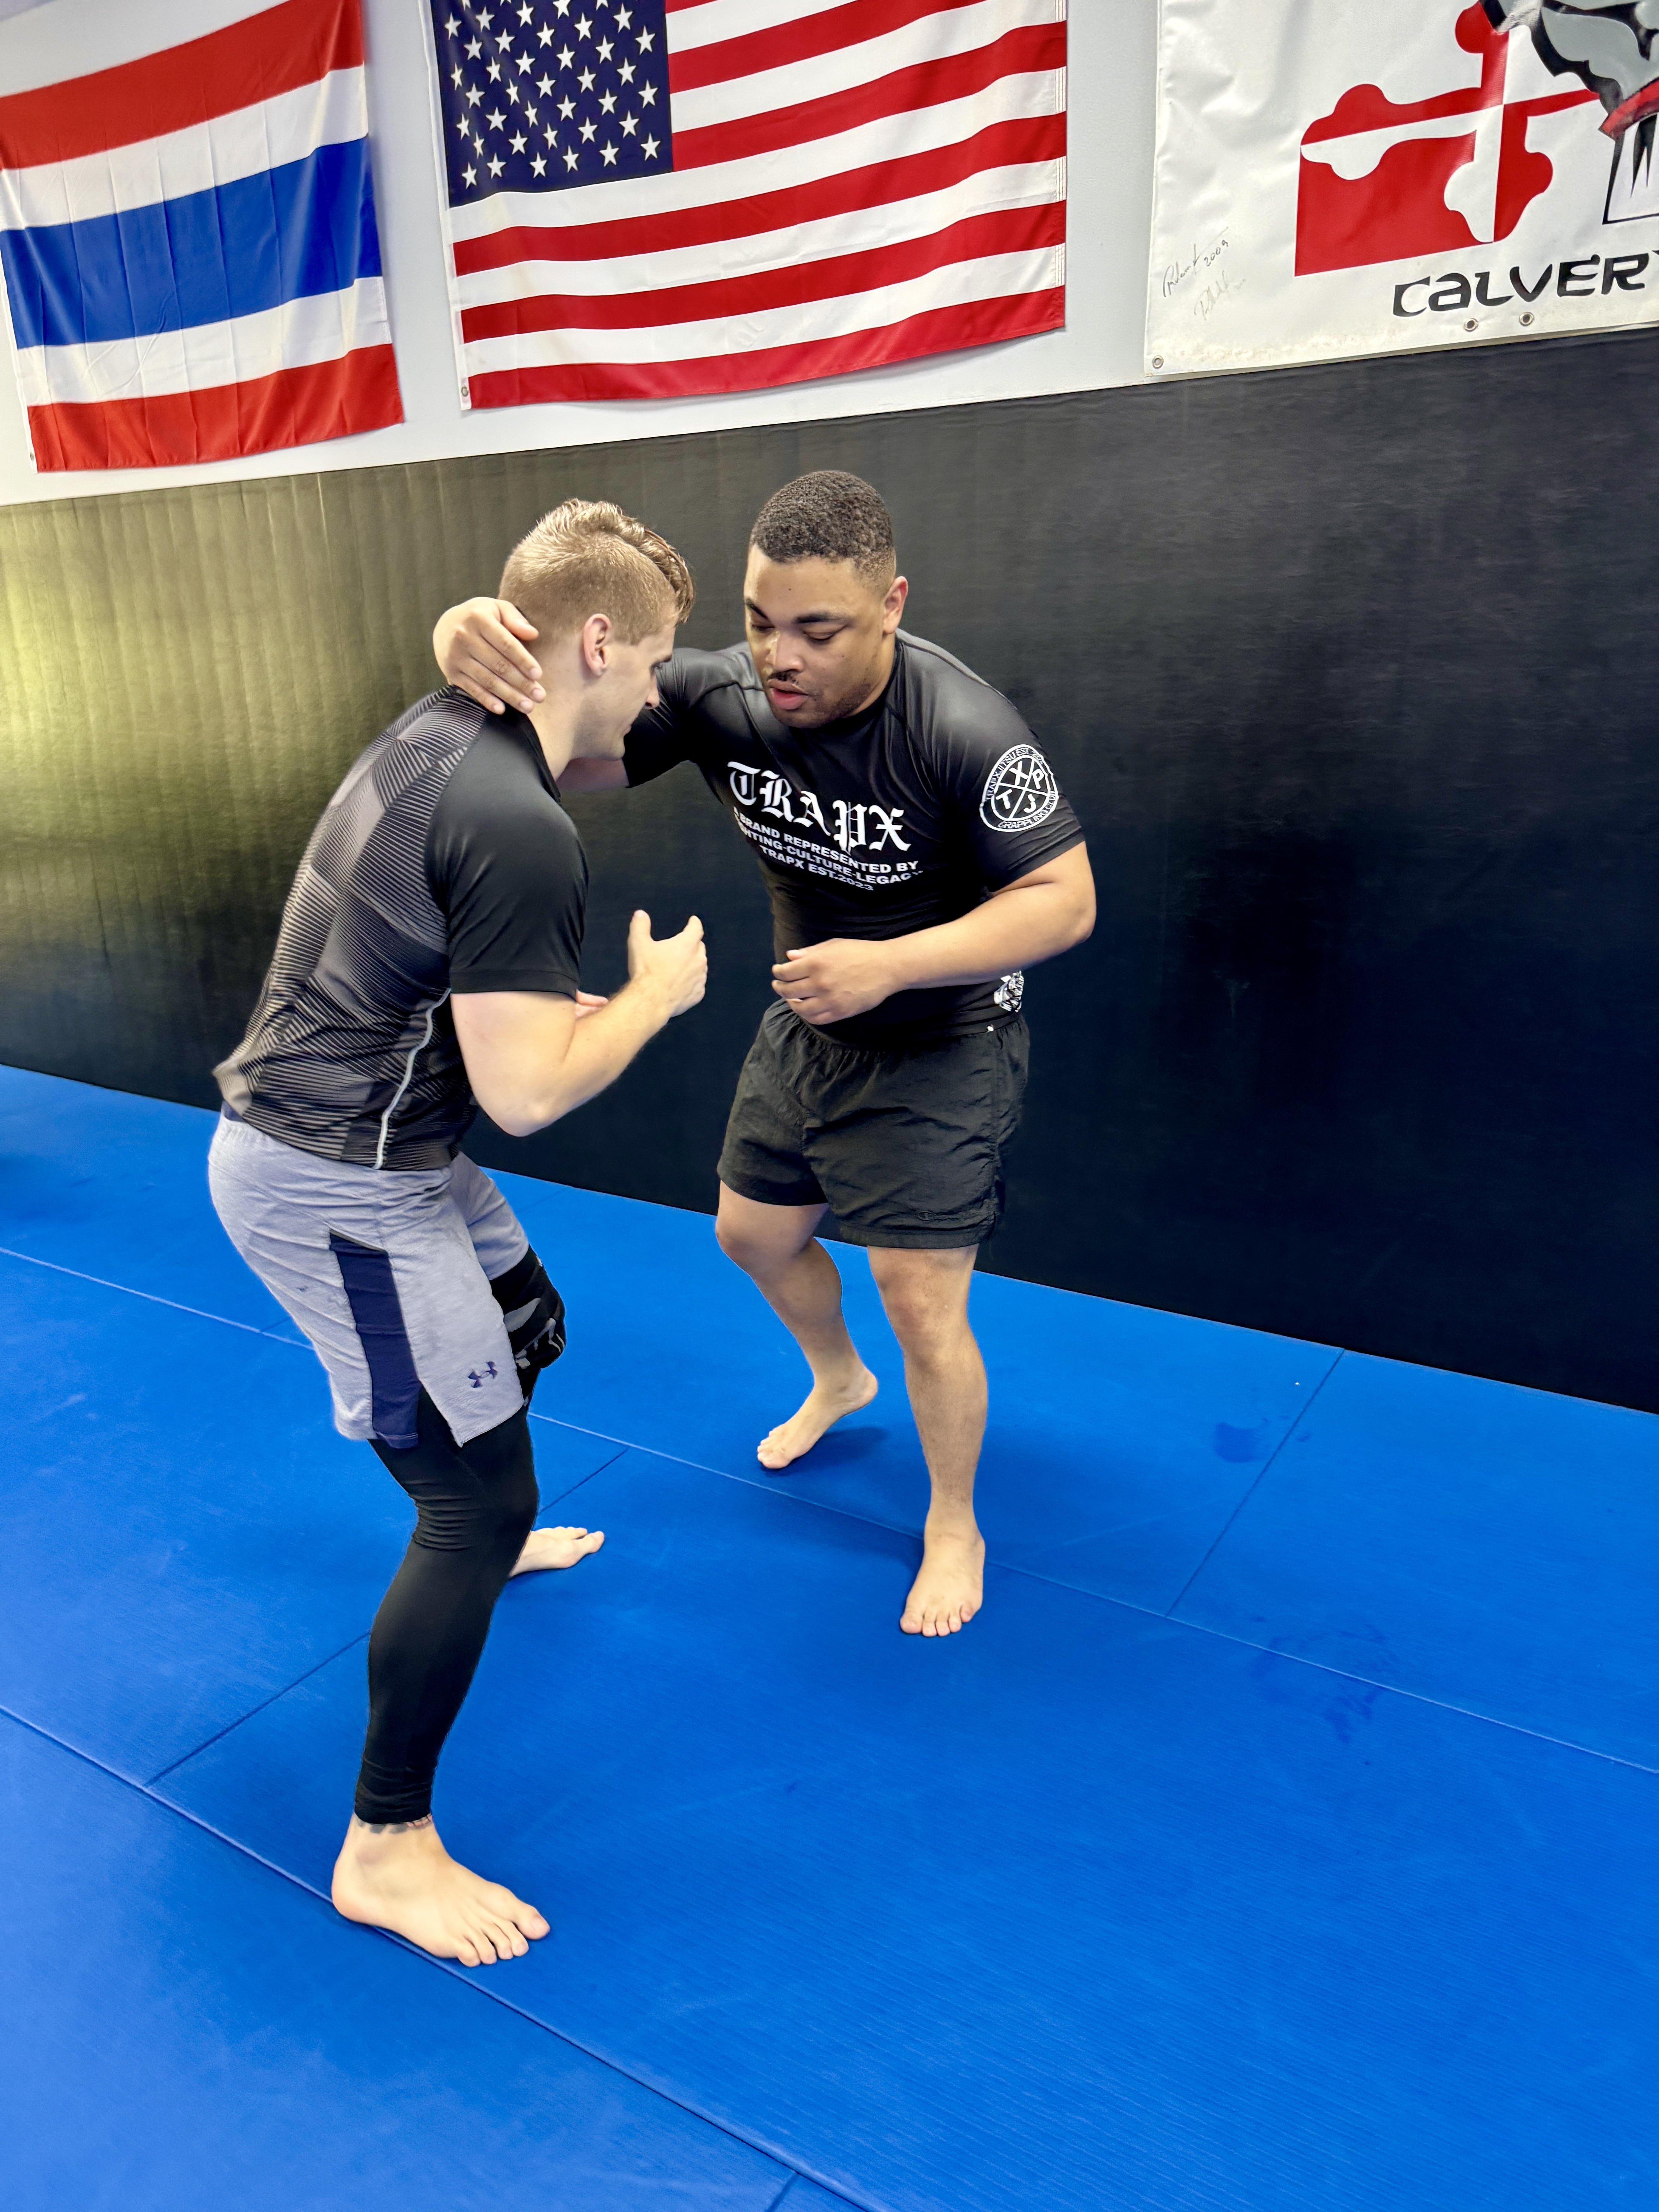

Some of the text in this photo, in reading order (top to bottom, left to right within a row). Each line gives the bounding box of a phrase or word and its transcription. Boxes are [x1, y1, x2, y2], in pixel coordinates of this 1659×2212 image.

[727, 761, 912, 856] TRAPX
[740, 812, 780, 838] BRAND
[783, 833, 891, 873] REPRESENTED
[896, 860, 919, 872] BY
[759, 845, 874, 890] TRAPX EST.2023
